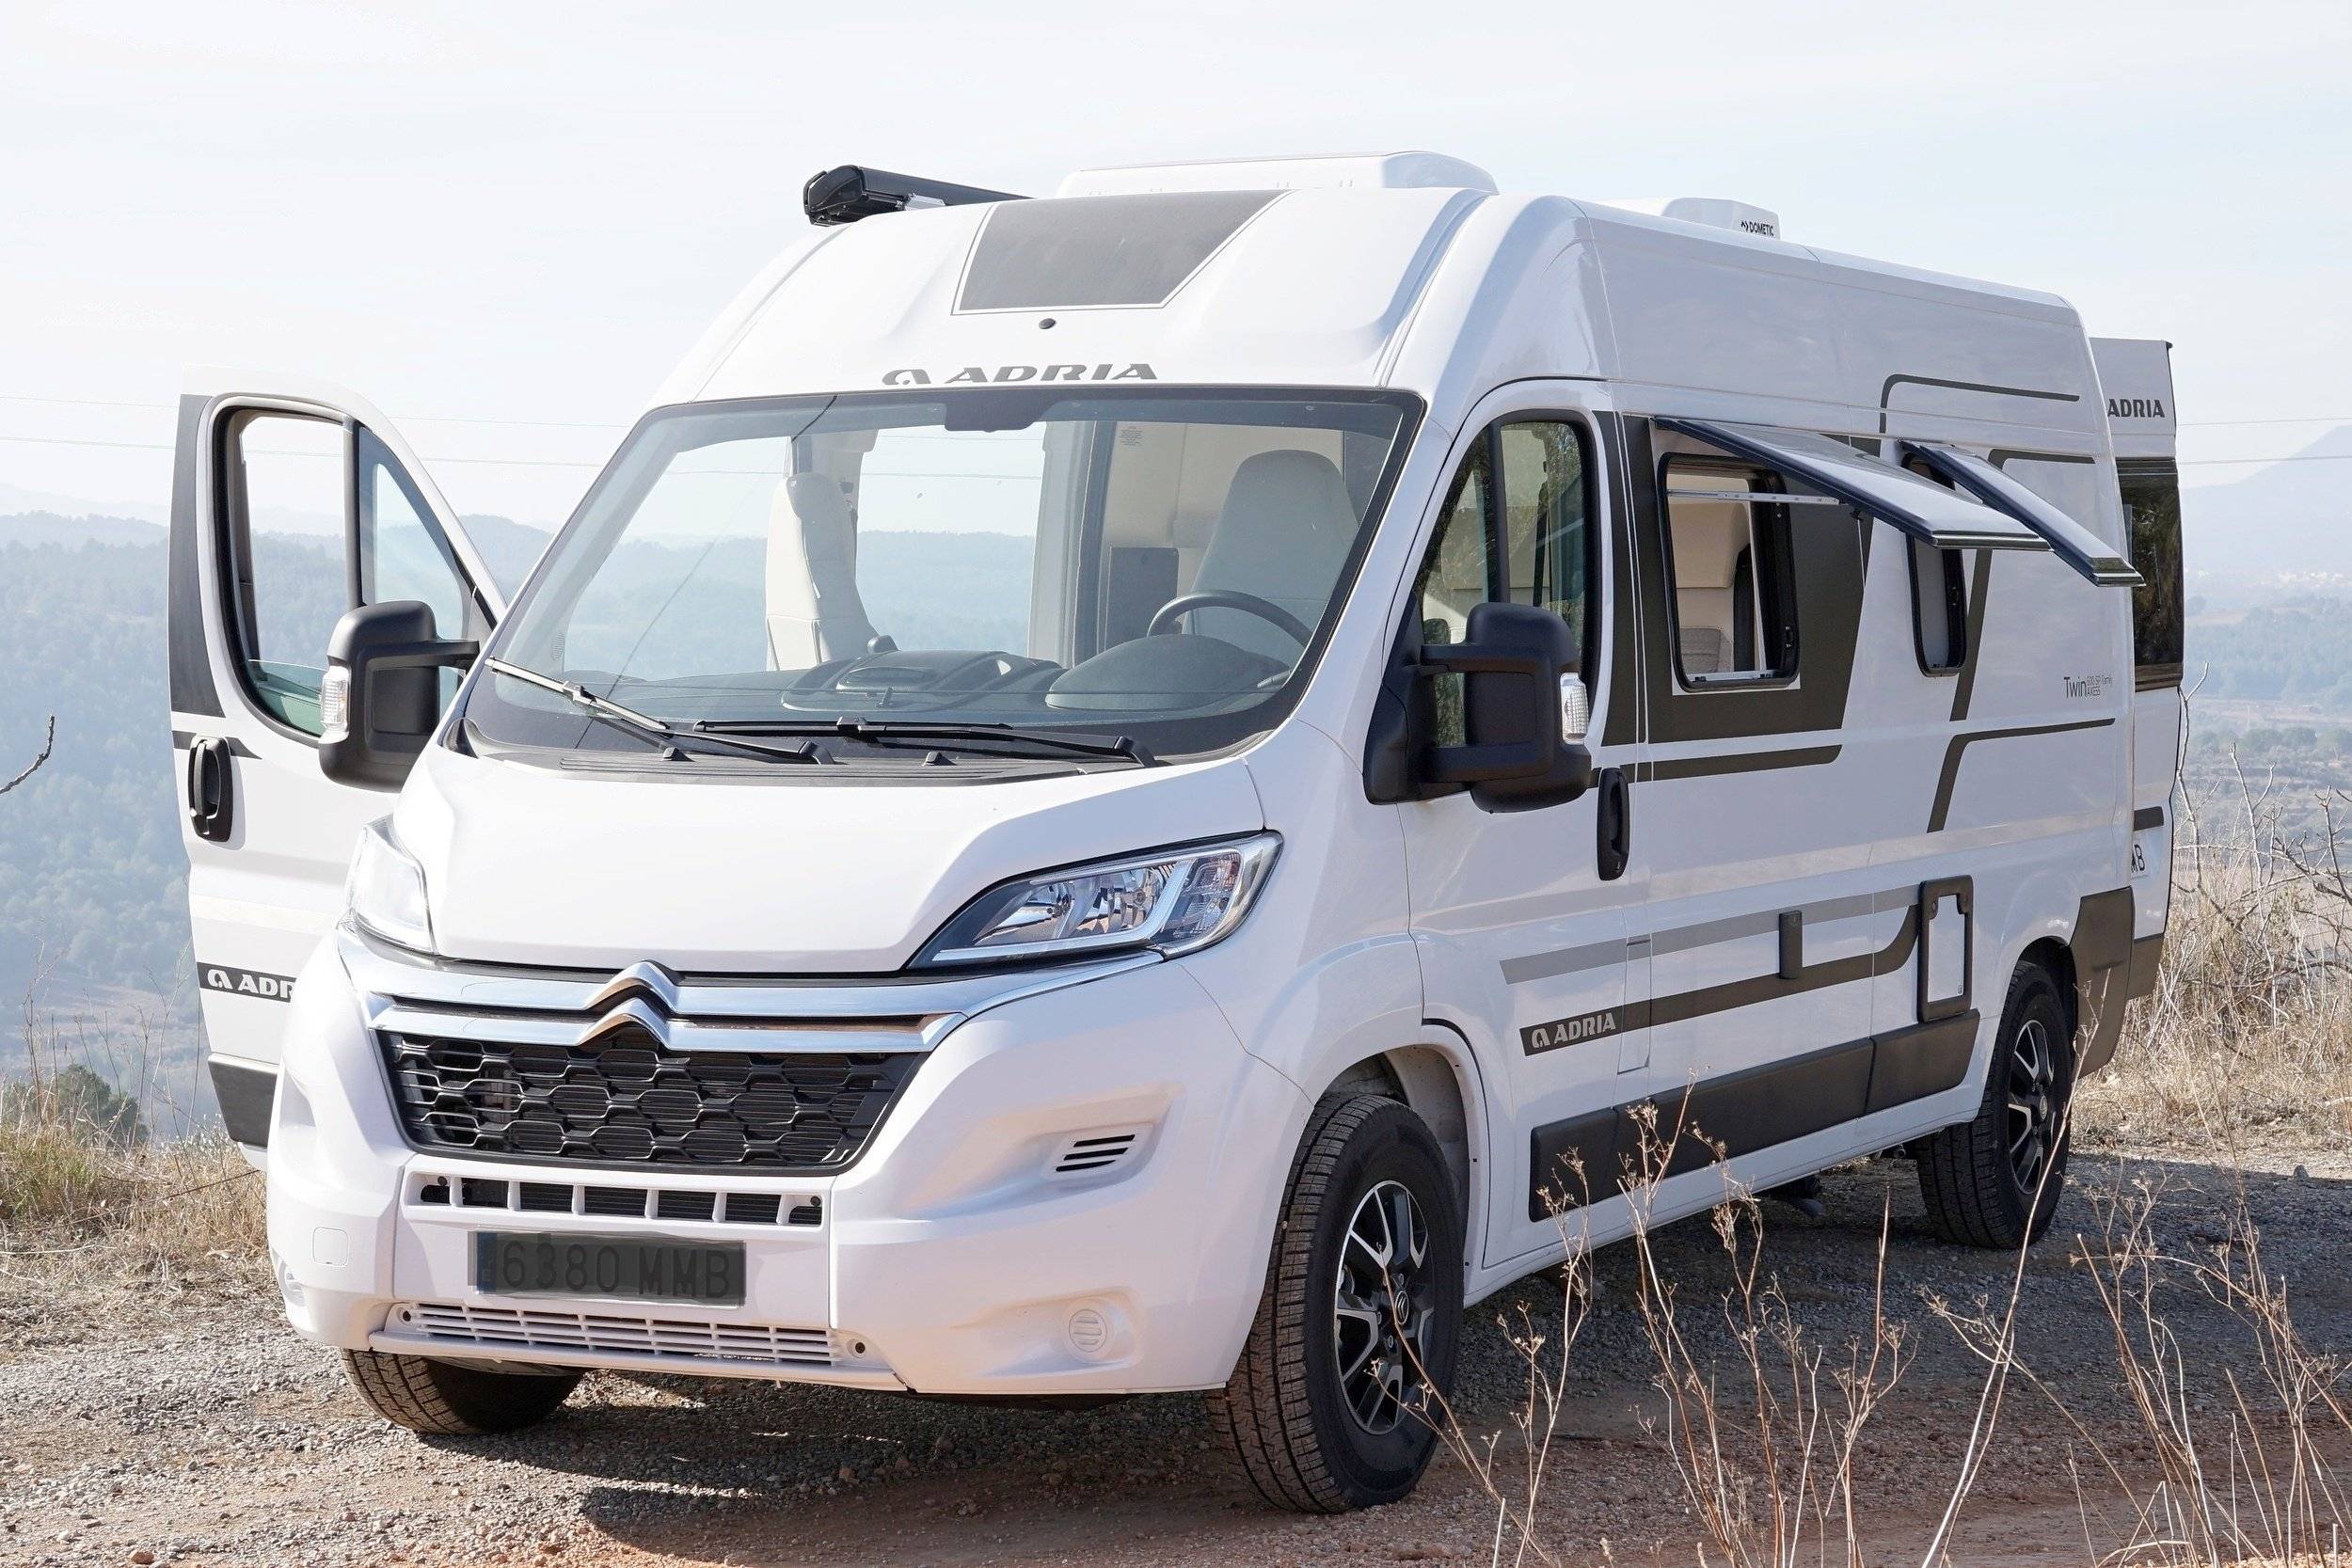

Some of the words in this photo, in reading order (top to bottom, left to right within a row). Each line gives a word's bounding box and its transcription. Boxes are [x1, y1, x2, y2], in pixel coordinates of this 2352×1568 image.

[1749, 221, 1774, 237] DOMETIC
[944, 363, 1158, 384] ADRIA
[2107, 398, 2166, 418] ADRIA
[2063, 676, 2087, 698] Twin
[1553, 1012, 1616, 1044] ADRIA
[502, 1240, 619, 1293] 6380
[638, 1246, 730, 1299] MMB
